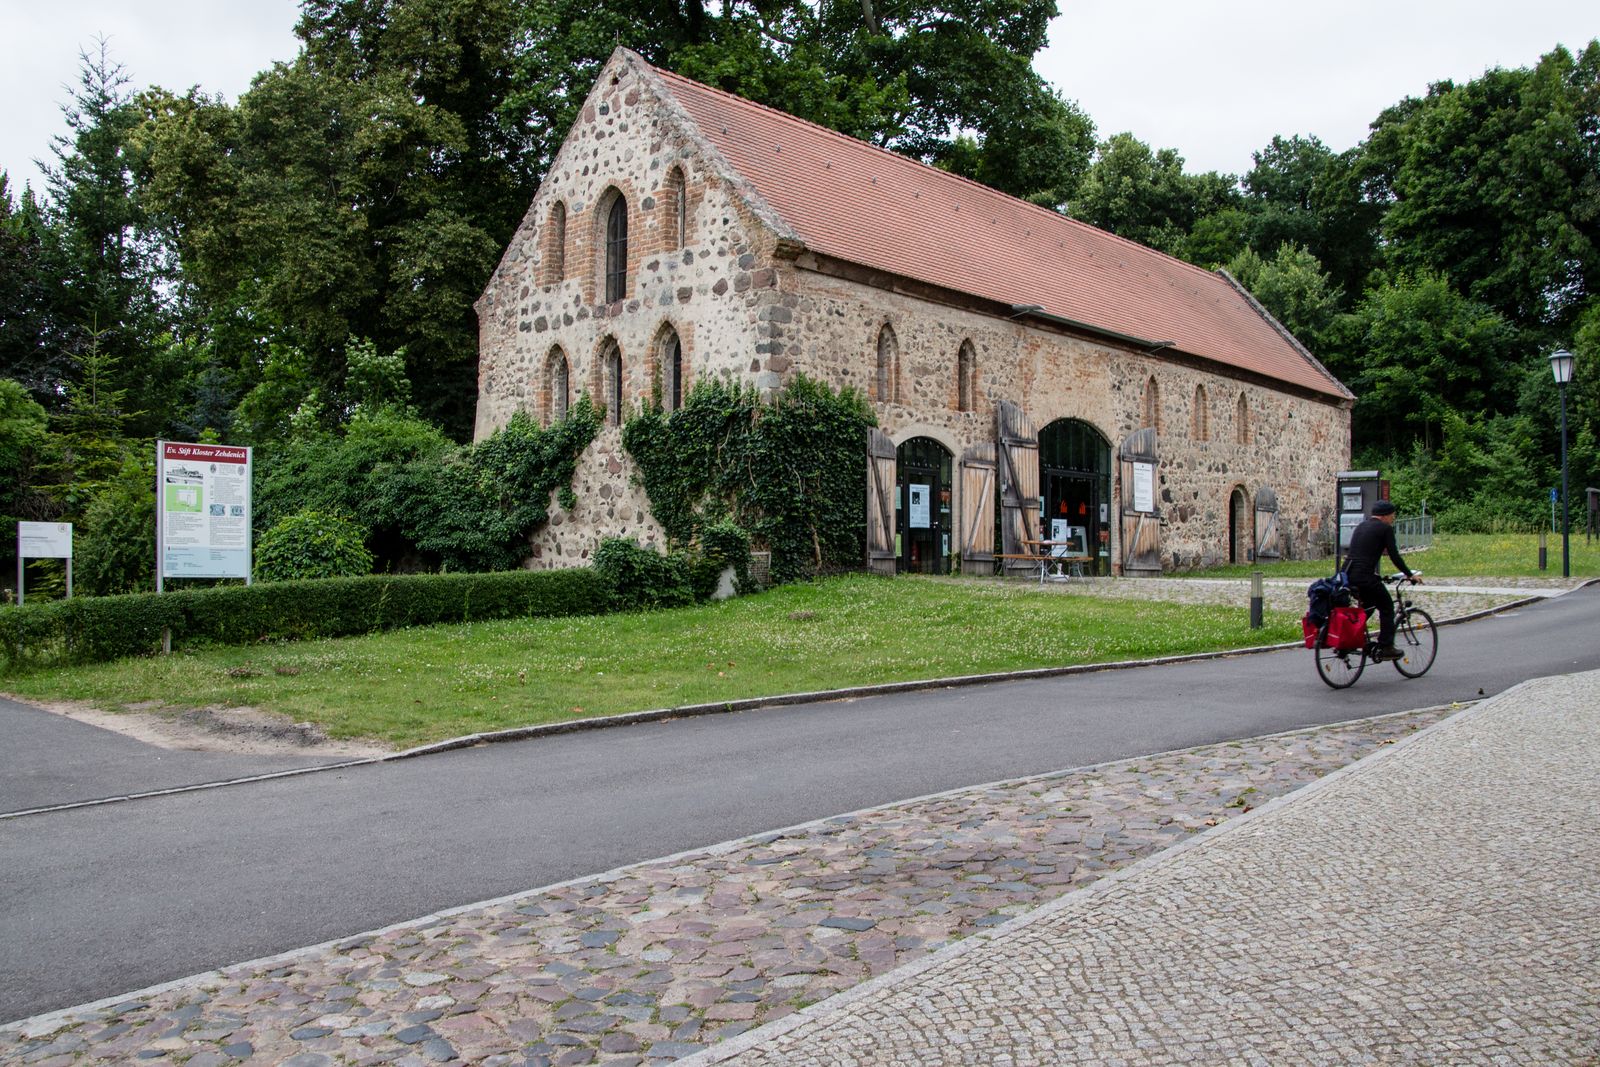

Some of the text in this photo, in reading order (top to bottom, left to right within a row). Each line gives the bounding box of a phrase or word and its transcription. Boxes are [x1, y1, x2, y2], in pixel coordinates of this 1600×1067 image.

[166, 446, 245, 458] Ev. Stift Kloster Zehdenick
